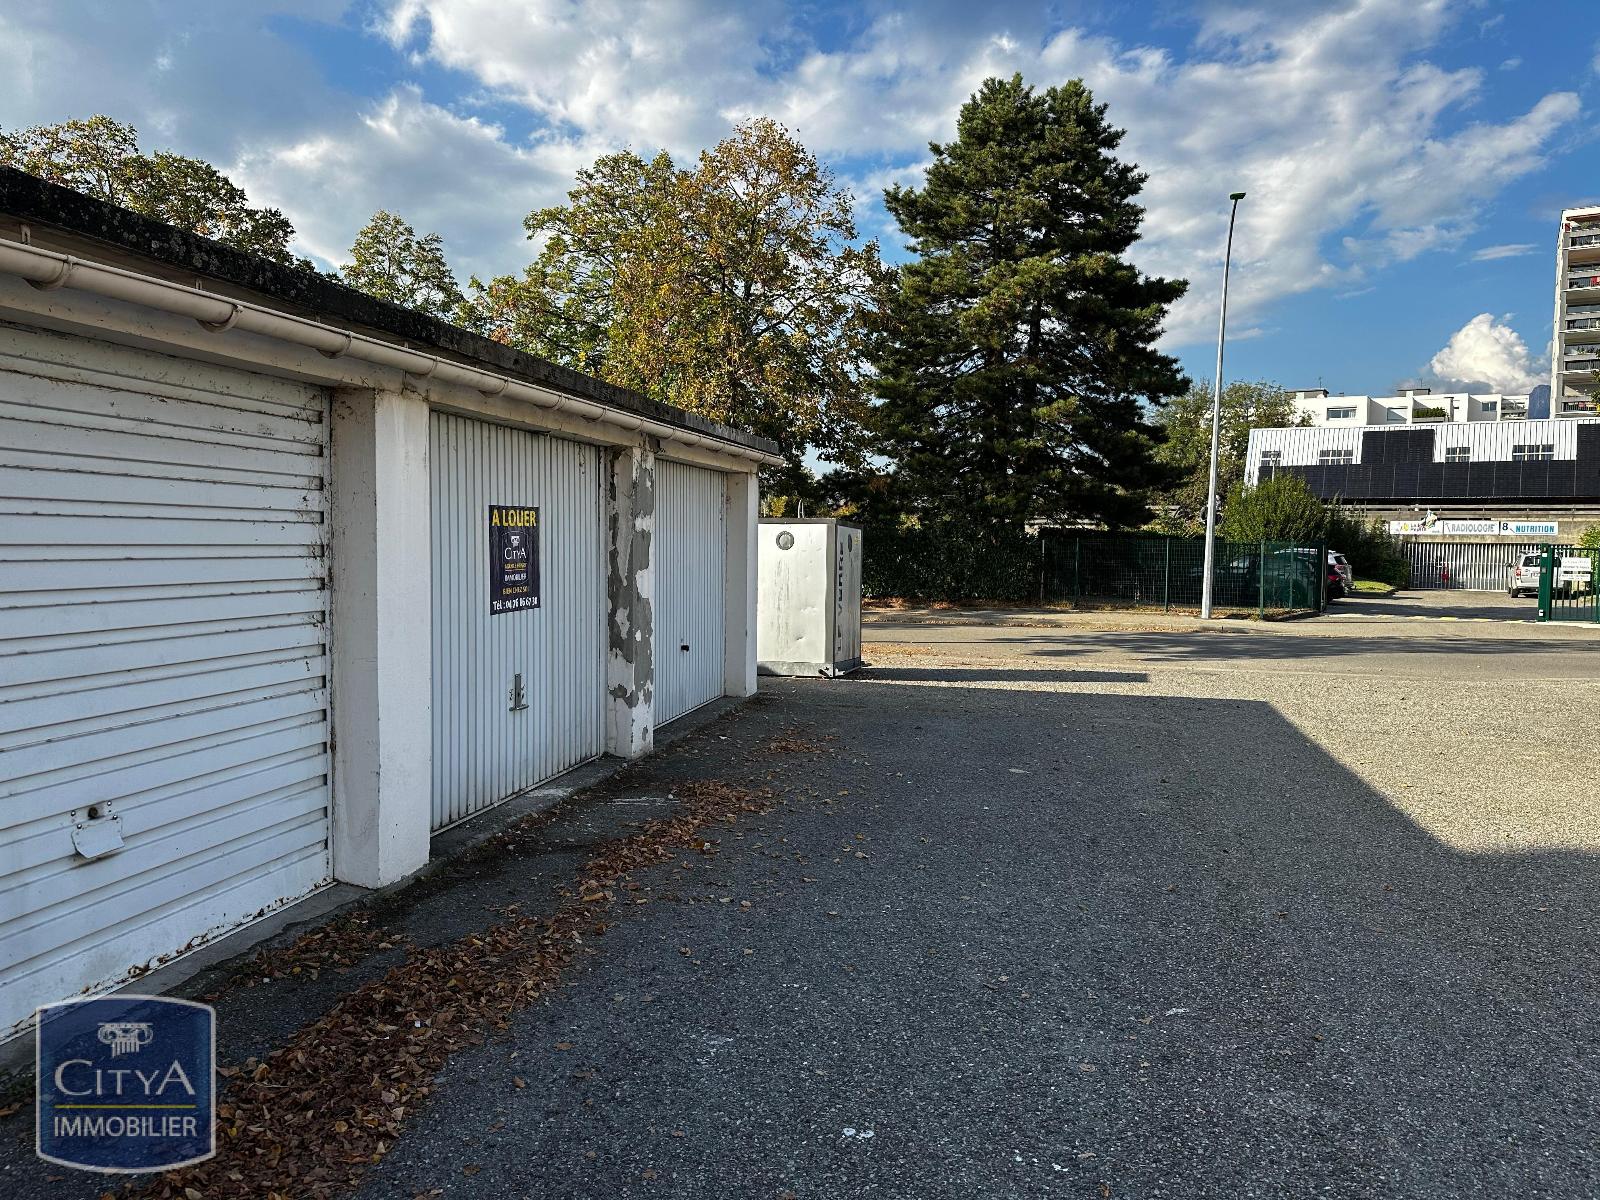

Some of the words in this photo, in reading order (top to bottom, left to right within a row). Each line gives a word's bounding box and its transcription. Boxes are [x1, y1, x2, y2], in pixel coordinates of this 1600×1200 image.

[492, 509, 501, 527] A
[502, 509, 537, 527] LOUER
[1451, 523, 1496, 533] RADIOLOGIE
[1502, 522, 1509, 531] 8
[1515, 525, 1555, 533] NUTRITION
